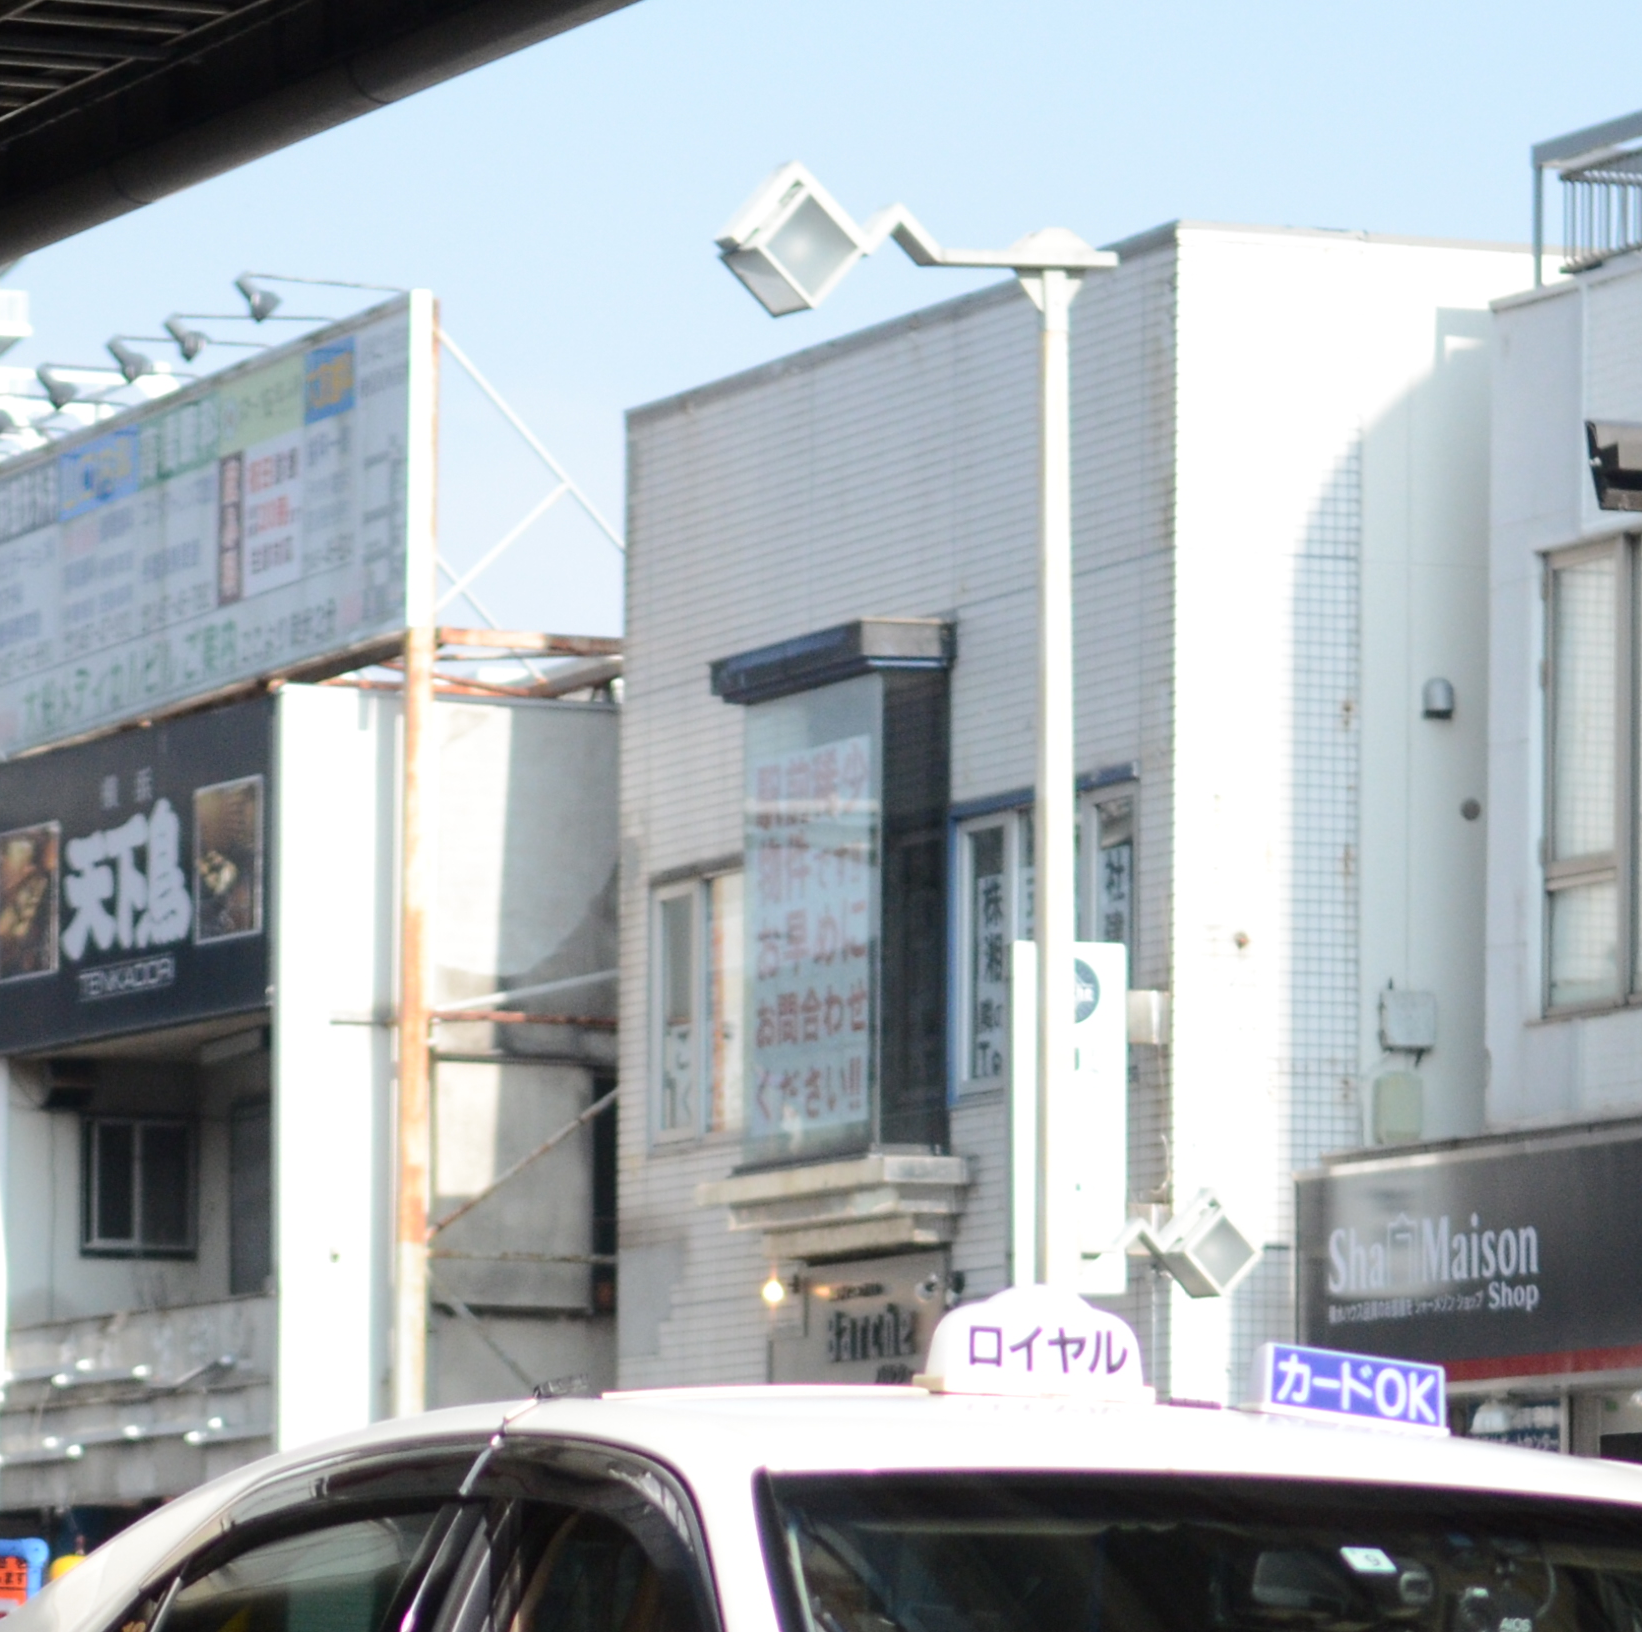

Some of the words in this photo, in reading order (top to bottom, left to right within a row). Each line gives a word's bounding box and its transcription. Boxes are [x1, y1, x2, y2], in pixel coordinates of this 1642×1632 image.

[1329, 1227, 1386, 1294] Sha
[1422, 1212, 1540, 1283] Maison
[1487, 1281, 1540, 1313] Shop
[969, 1325, 1128, 1376] ロイヤル
[1276, 1357, 1438, 1425] カードOK
